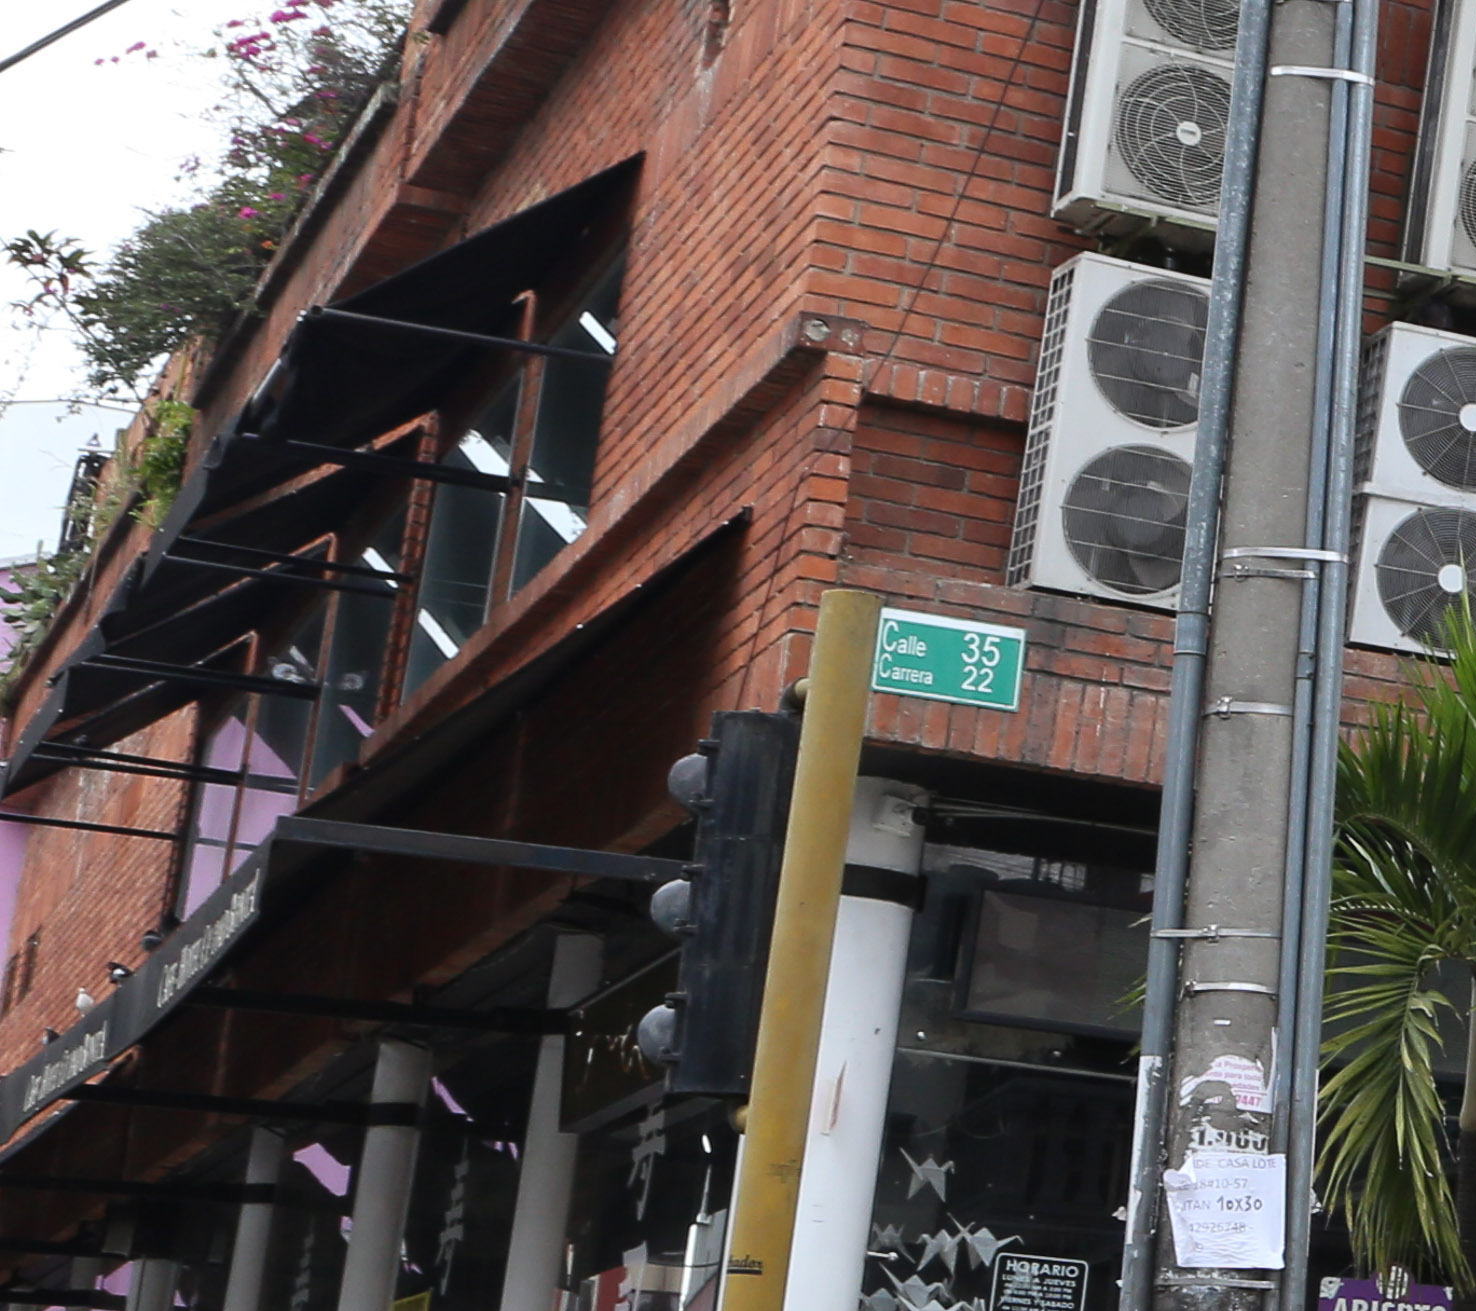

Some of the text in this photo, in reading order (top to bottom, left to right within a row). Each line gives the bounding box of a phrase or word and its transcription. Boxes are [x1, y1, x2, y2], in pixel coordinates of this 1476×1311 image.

[882, 620, 1001, 667] Calle 35
[878, 653, 994, 693] Carrera 22
[1005, 1260, 1079, 1278] HORARIO
